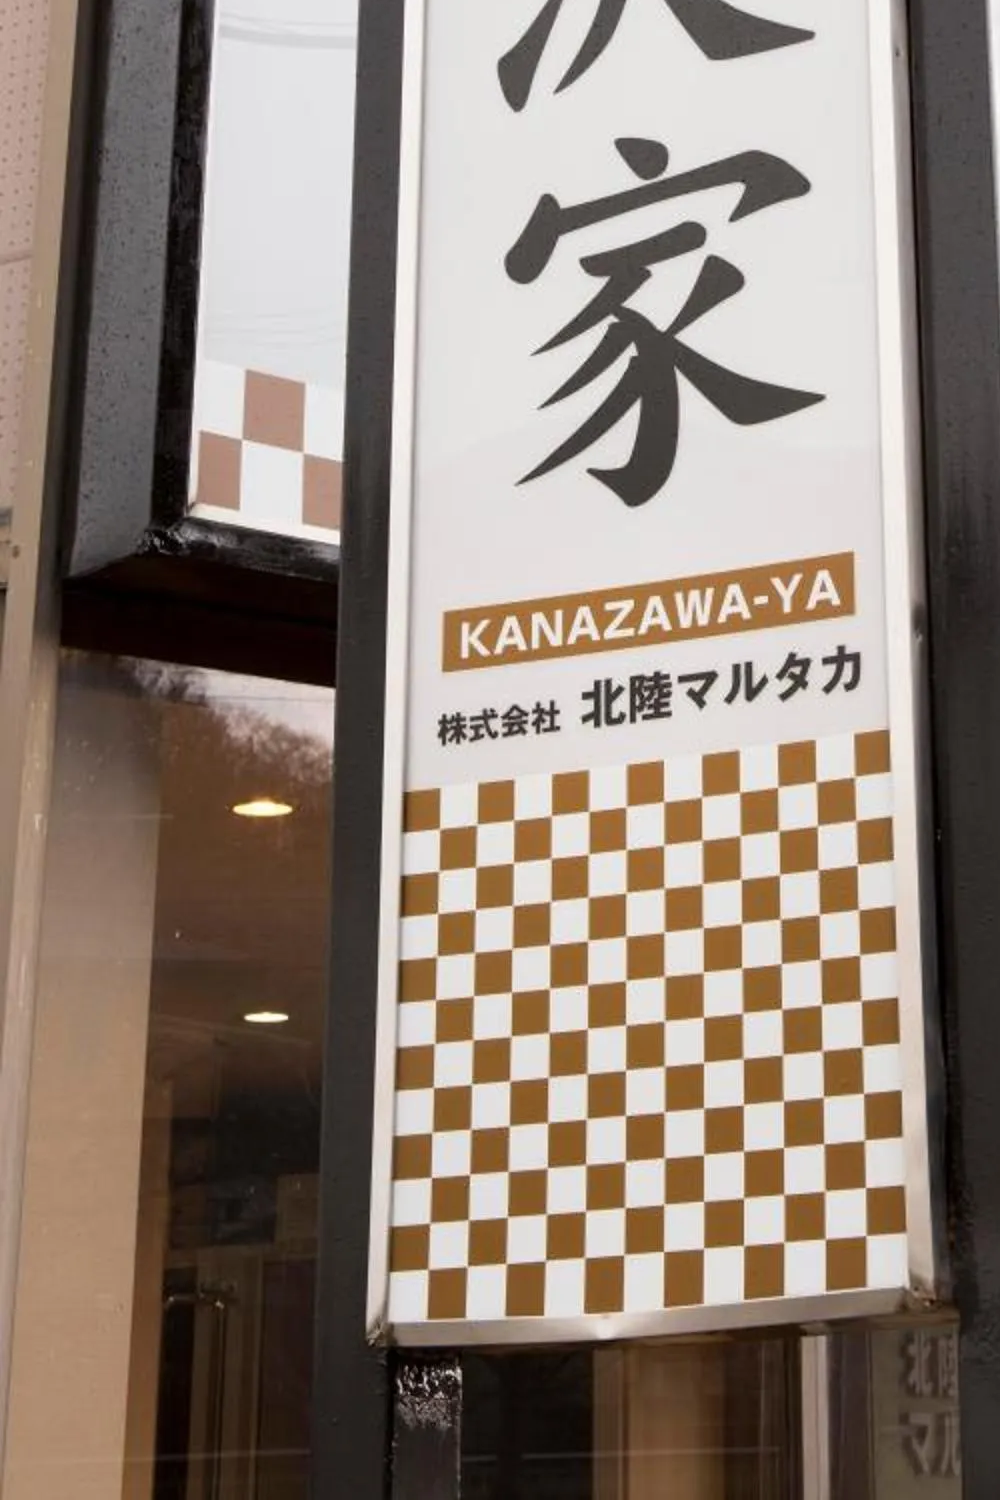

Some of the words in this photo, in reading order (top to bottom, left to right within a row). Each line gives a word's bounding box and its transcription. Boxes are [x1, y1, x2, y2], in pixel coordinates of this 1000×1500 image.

[459, 569, 842, 660] KANAZAWA-YA
[436, 699, 562, 747] 株式会社
[580, 644, 863, 729] 北陸マルタカ
